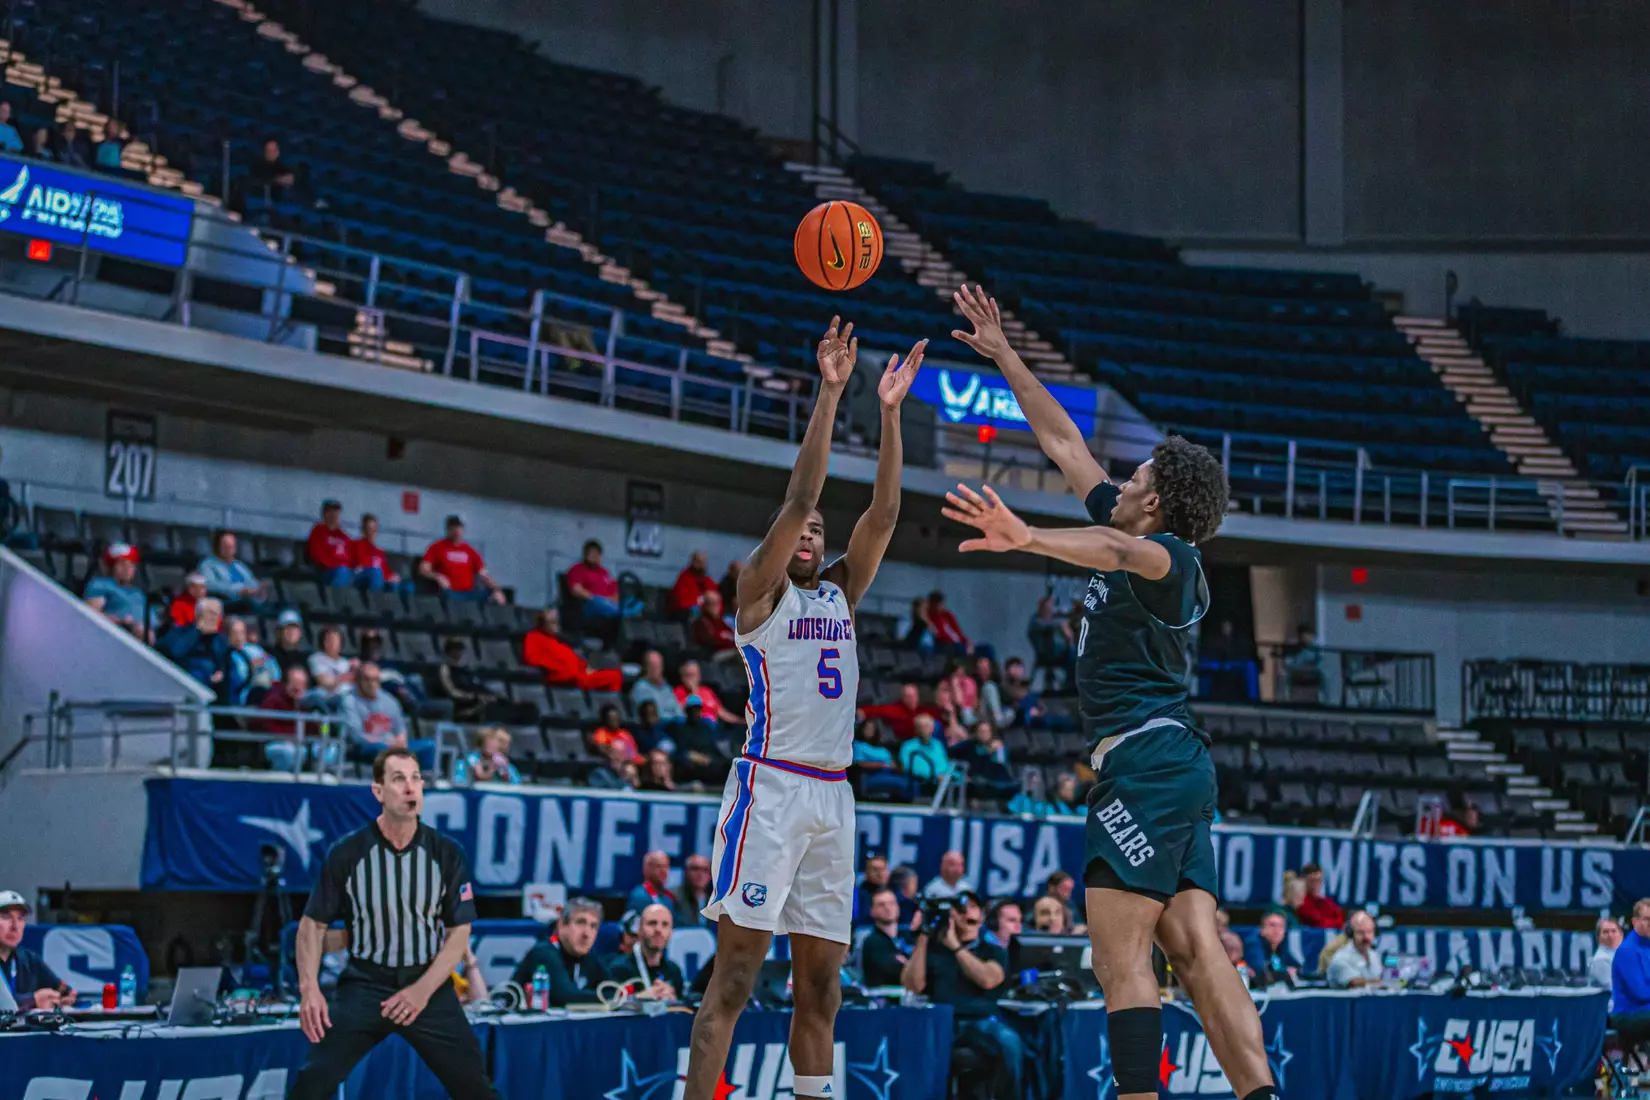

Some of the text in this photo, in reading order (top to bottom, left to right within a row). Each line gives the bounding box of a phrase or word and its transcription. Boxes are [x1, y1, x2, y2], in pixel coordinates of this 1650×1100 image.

[108, 441, 154, 498] 207
[817, 648, 843, 699] 5
[947, 817, 1061, 897] USA
[1096, 798, 1155, 867] BEARS
[1448, 847, 1516, 907] ON
[1542, 846, 1614, 908] US
